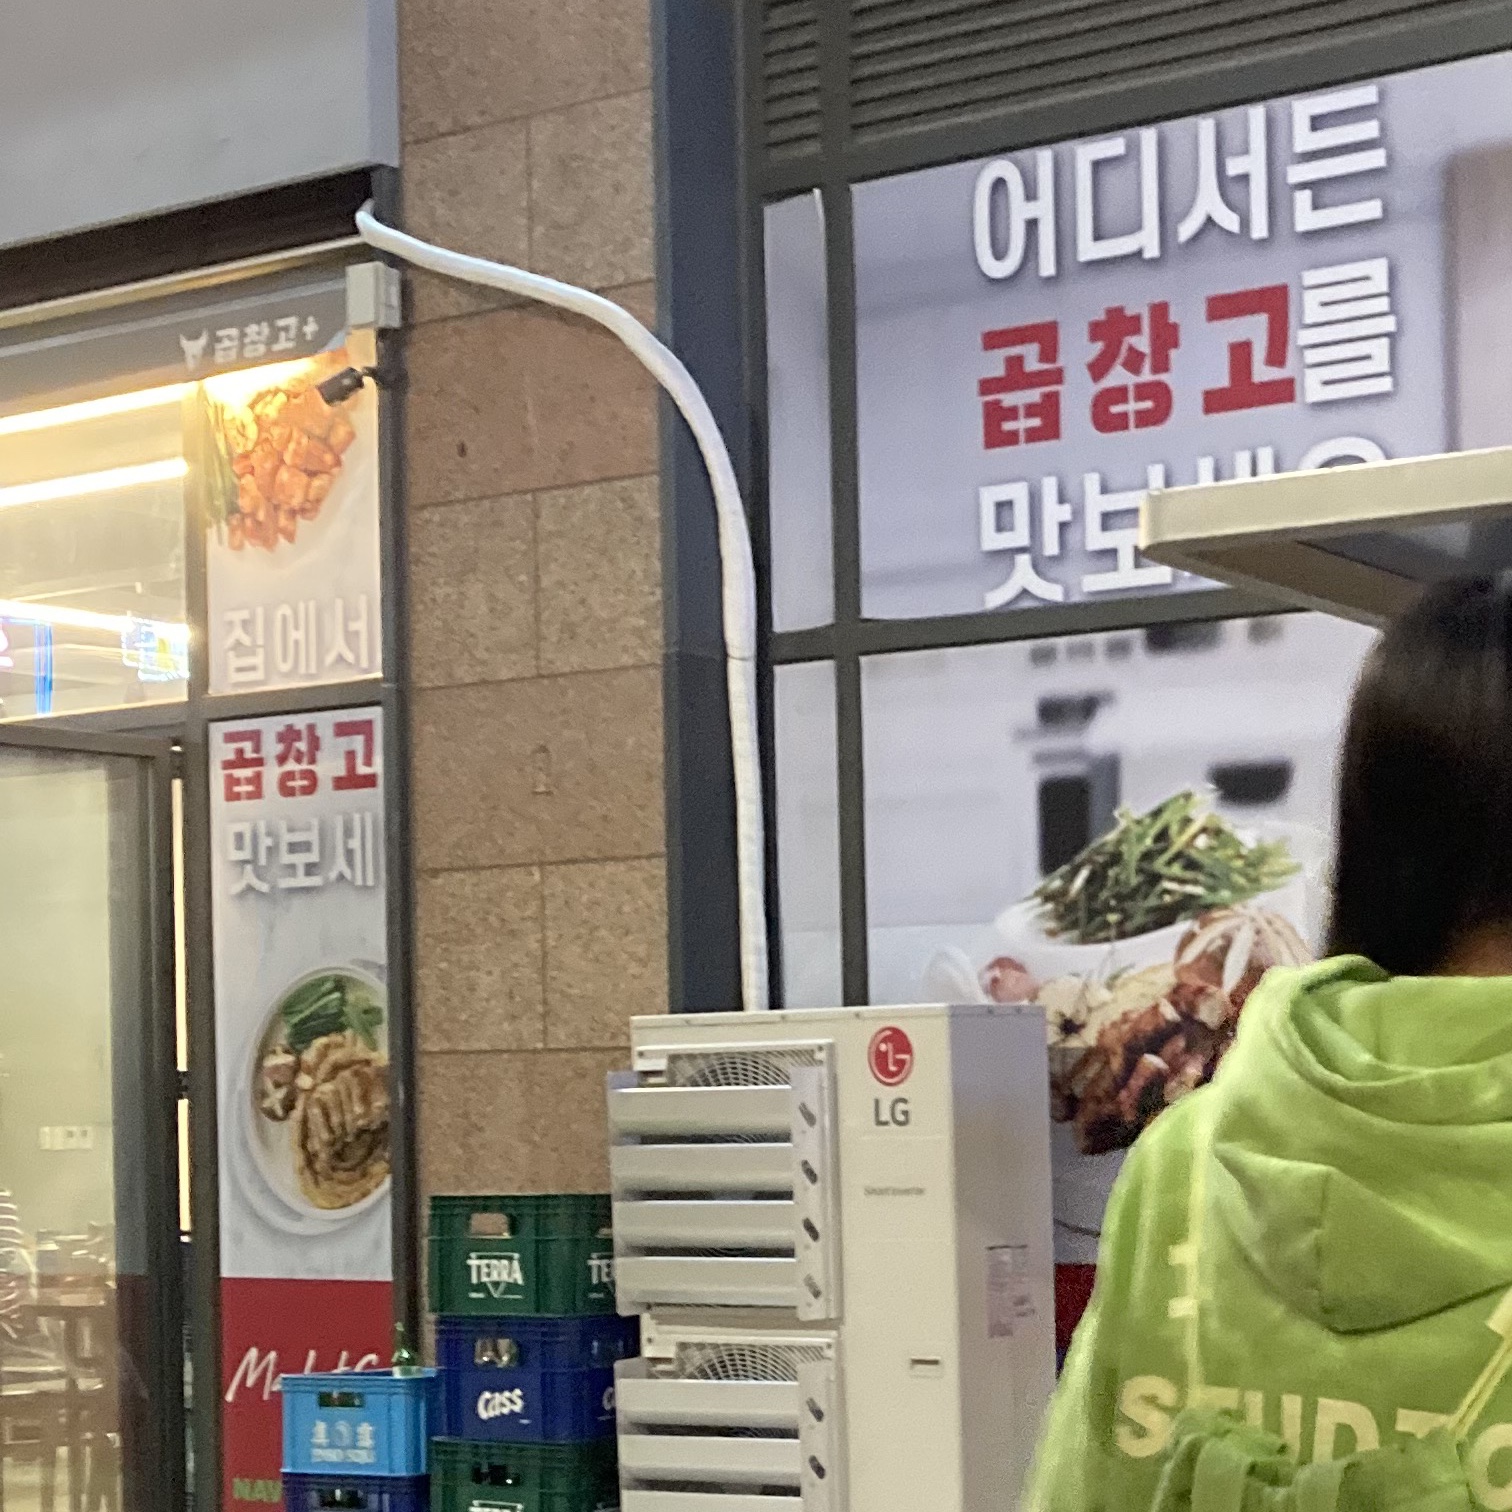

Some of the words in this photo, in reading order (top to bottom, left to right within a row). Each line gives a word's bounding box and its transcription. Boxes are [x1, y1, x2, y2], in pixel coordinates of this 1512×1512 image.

[973, 85, 1387, 279] 어디서든
[978, 256, 1397, 450] 곱창고를
[223, 595, 369, 683] 집에서
[221, 719, 378, 802] 곱창고
[227, 812, 375, 895] 맛보세
[874, 1097, 910, 1127] LG
[466, 1257, 525, 1287] TERRA
